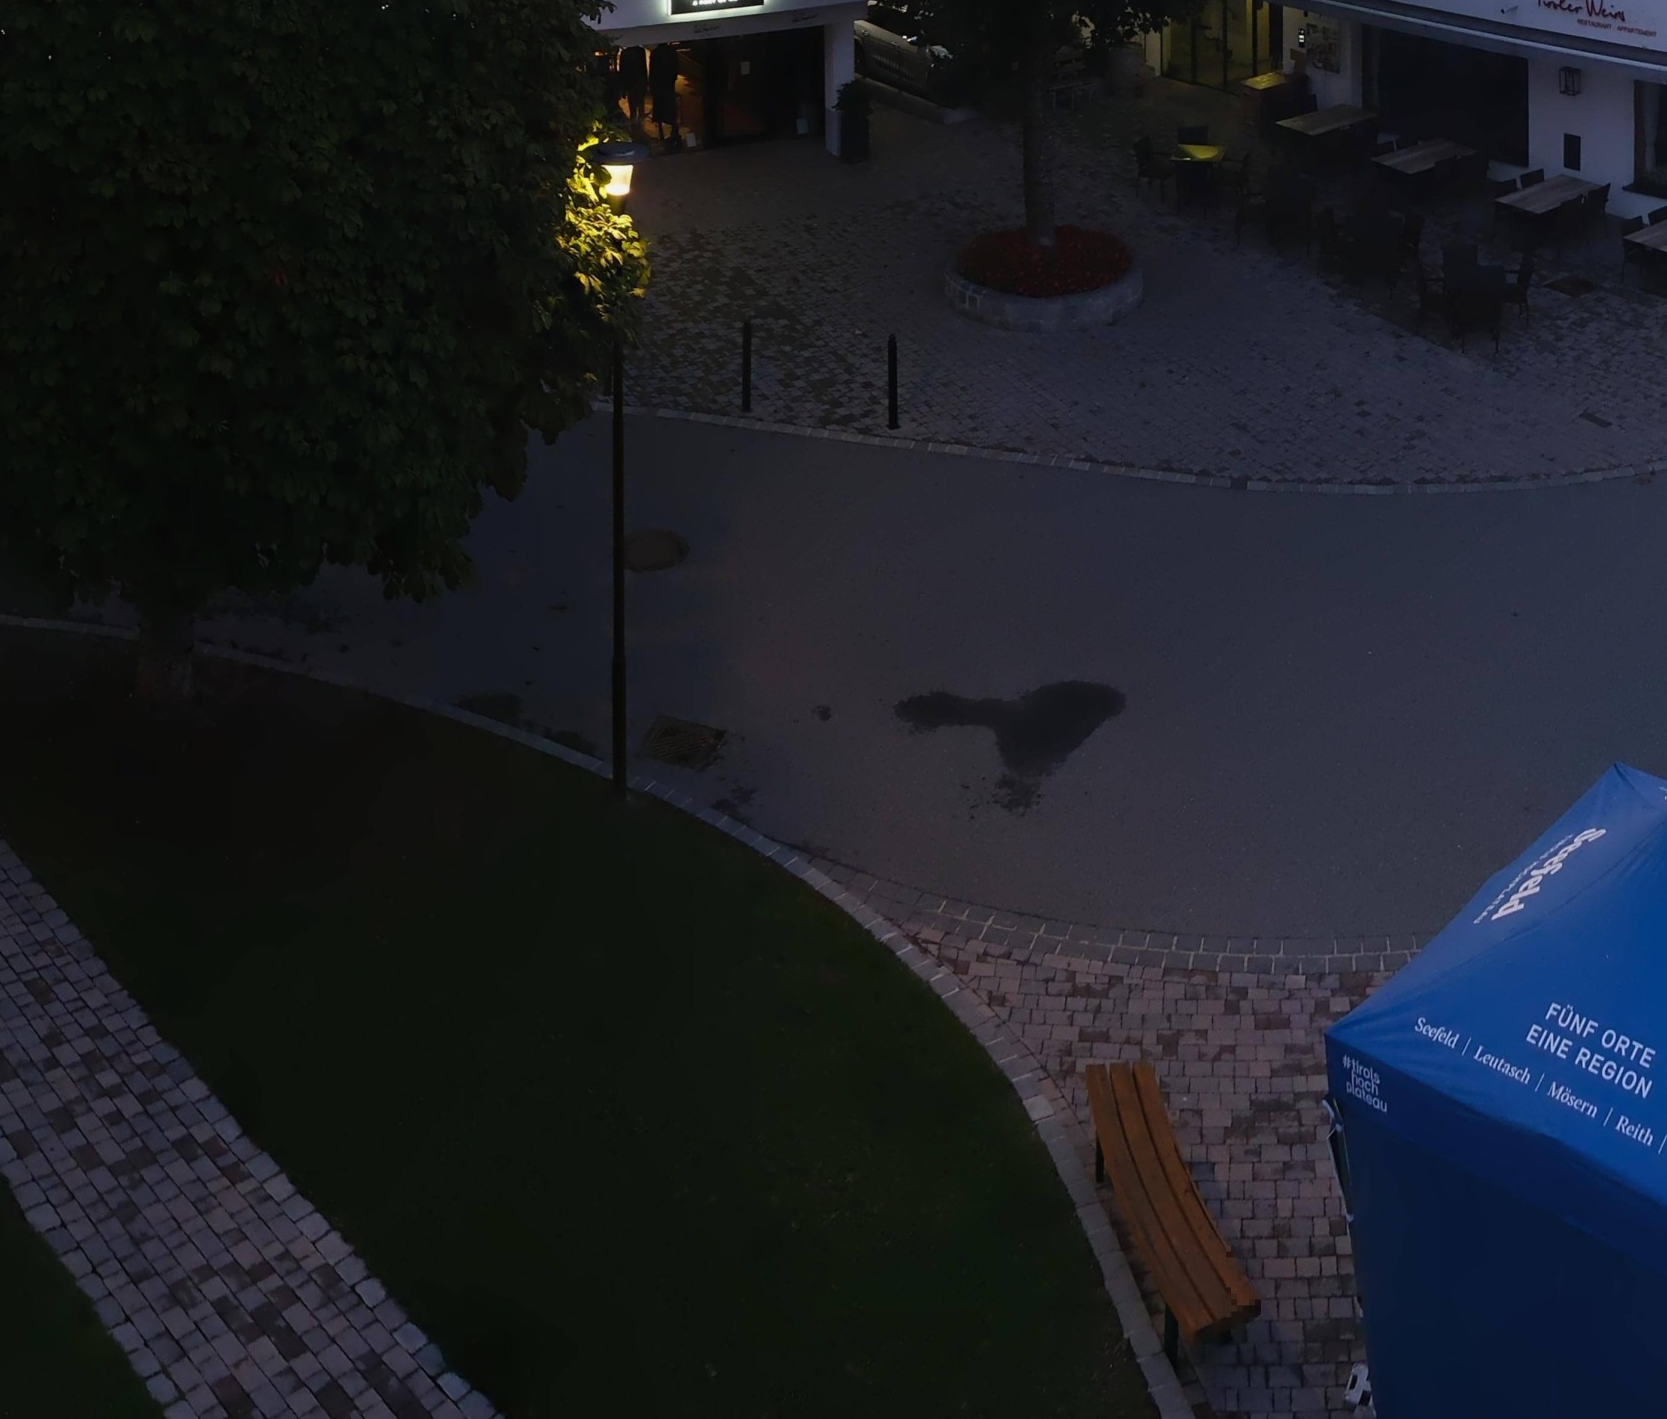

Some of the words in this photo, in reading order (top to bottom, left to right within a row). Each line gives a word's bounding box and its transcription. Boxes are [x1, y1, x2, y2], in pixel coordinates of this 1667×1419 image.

[1491, 828, 1607, 921] Seefeld
[1342, 1054, 1380, 1085] #tirols
[1525, 1025, 1573, 1060] EINE
[1574, 1047, 1653, 1099] REGION
[1545, 1001, 1599, 1038] FÜNF
[1600, 1029, 1656, 1070] ORTE
[1346, 1082, 1388, 1114] plateau
[1350, 1070, 1379, 1097] hoch
[1414, 1017, 1460, 1050] Seefeld
[1473, 1045, 1531, 1085] Leutasch
[1546, 1081, 1598, 1118] Mösern
[1615, 1115, 1654, 1146] Reith
